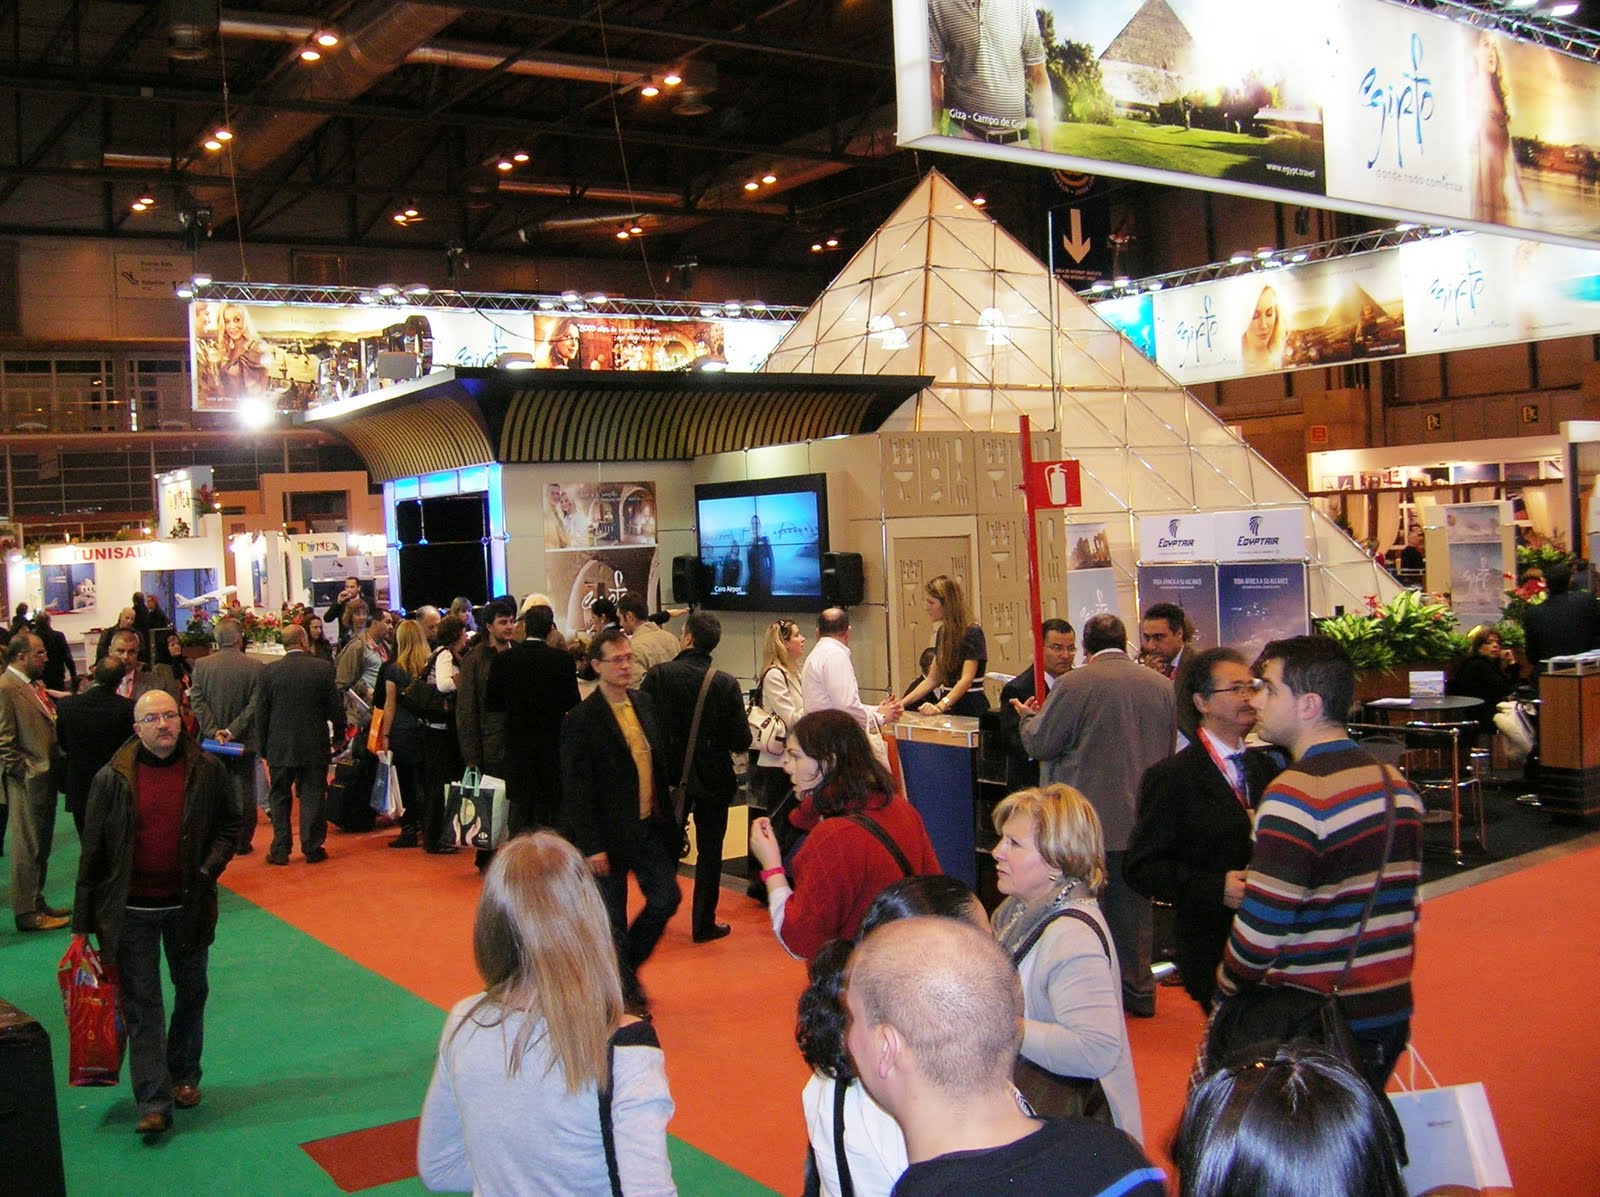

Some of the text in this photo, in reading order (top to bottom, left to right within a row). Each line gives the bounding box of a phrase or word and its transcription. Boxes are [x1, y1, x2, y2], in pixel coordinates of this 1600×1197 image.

[949, 108, 966, 120] Giza
[973, 112, 999, 126] Campo
[1000, 117, 1010, 127] de
[1266, 163, 1316, 178] www.egypt.travel
[714, 585, 742, 594] Cairo Airport
